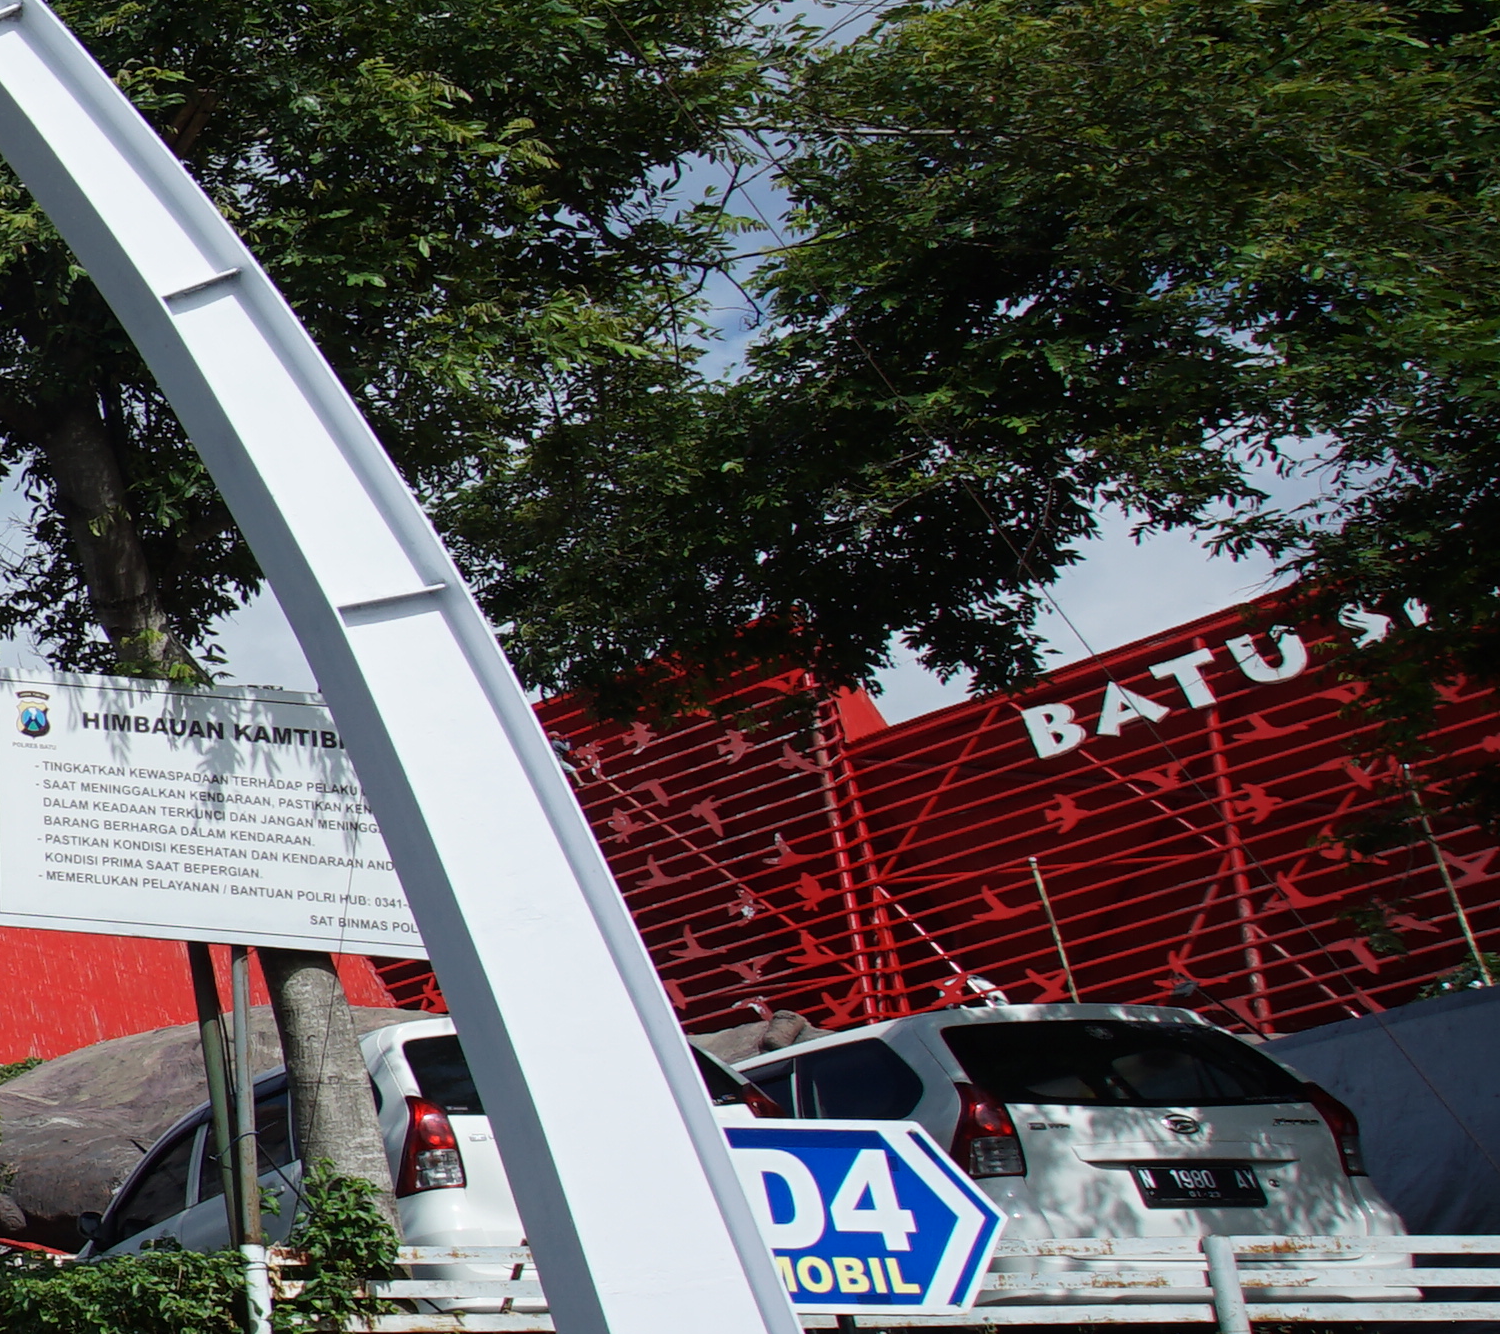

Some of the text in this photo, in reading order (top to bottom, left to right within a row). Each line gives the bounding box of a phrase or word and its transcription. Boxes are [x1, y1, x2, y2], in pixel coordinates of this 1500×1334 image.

[1020, 623, 1310, 761] BATU
[82, 711, 224, 740] HIMBAUAN
[42, 760, 125, 777] TINGKATKAN
[129, 768, 228, 785] KEWASPADAAN
[232, 775, 302, 791] TERHADAP
[307, 782, 358, 796] PELAKU
[43, 779, 76, 791] SAAT
[80, 782, 185, 800] MENINGGALKAN
[190, 790, 274, 809] KENDARAAN,
[278, 797, 342, 812] PASTIKAN
[43, 797, 381, 834] DALAM KEADAAN TERKUNCI DAN JANGAN MENINGG
[43, 816, 315, 847] BARANG BERHARGA DALAM KENDARAAN.
[45, 834, 109, 848] PASTIKAN
[113, 839, 166, 852] KONDISI
[170, 844, 246, 859] KESEHATAN
[251, 850, 278, 862] DAN
[282, 853, 363, 869] KENDARAAN
[45, 852, 263, 879] KONDISI PRIMA SAAT BEPERGIAN.
[46, 870, 138, 887] MEMERLUKAN
[142, 877, 219, 893] PELAYANAN
[230, 885, 293, 900] BANTUAN
[297, 890, 336, 903] POLRI
[340, 895, 371, 906] HUB:
[375, 897, 410, 909] 0341-
[310, 914, 334, 927] SAT
[338, 917, 388, 931] BINMAS
[1138, 1169, 1257, 1189] N 1980 AY
[732, 1148, 918, 1252] D4
